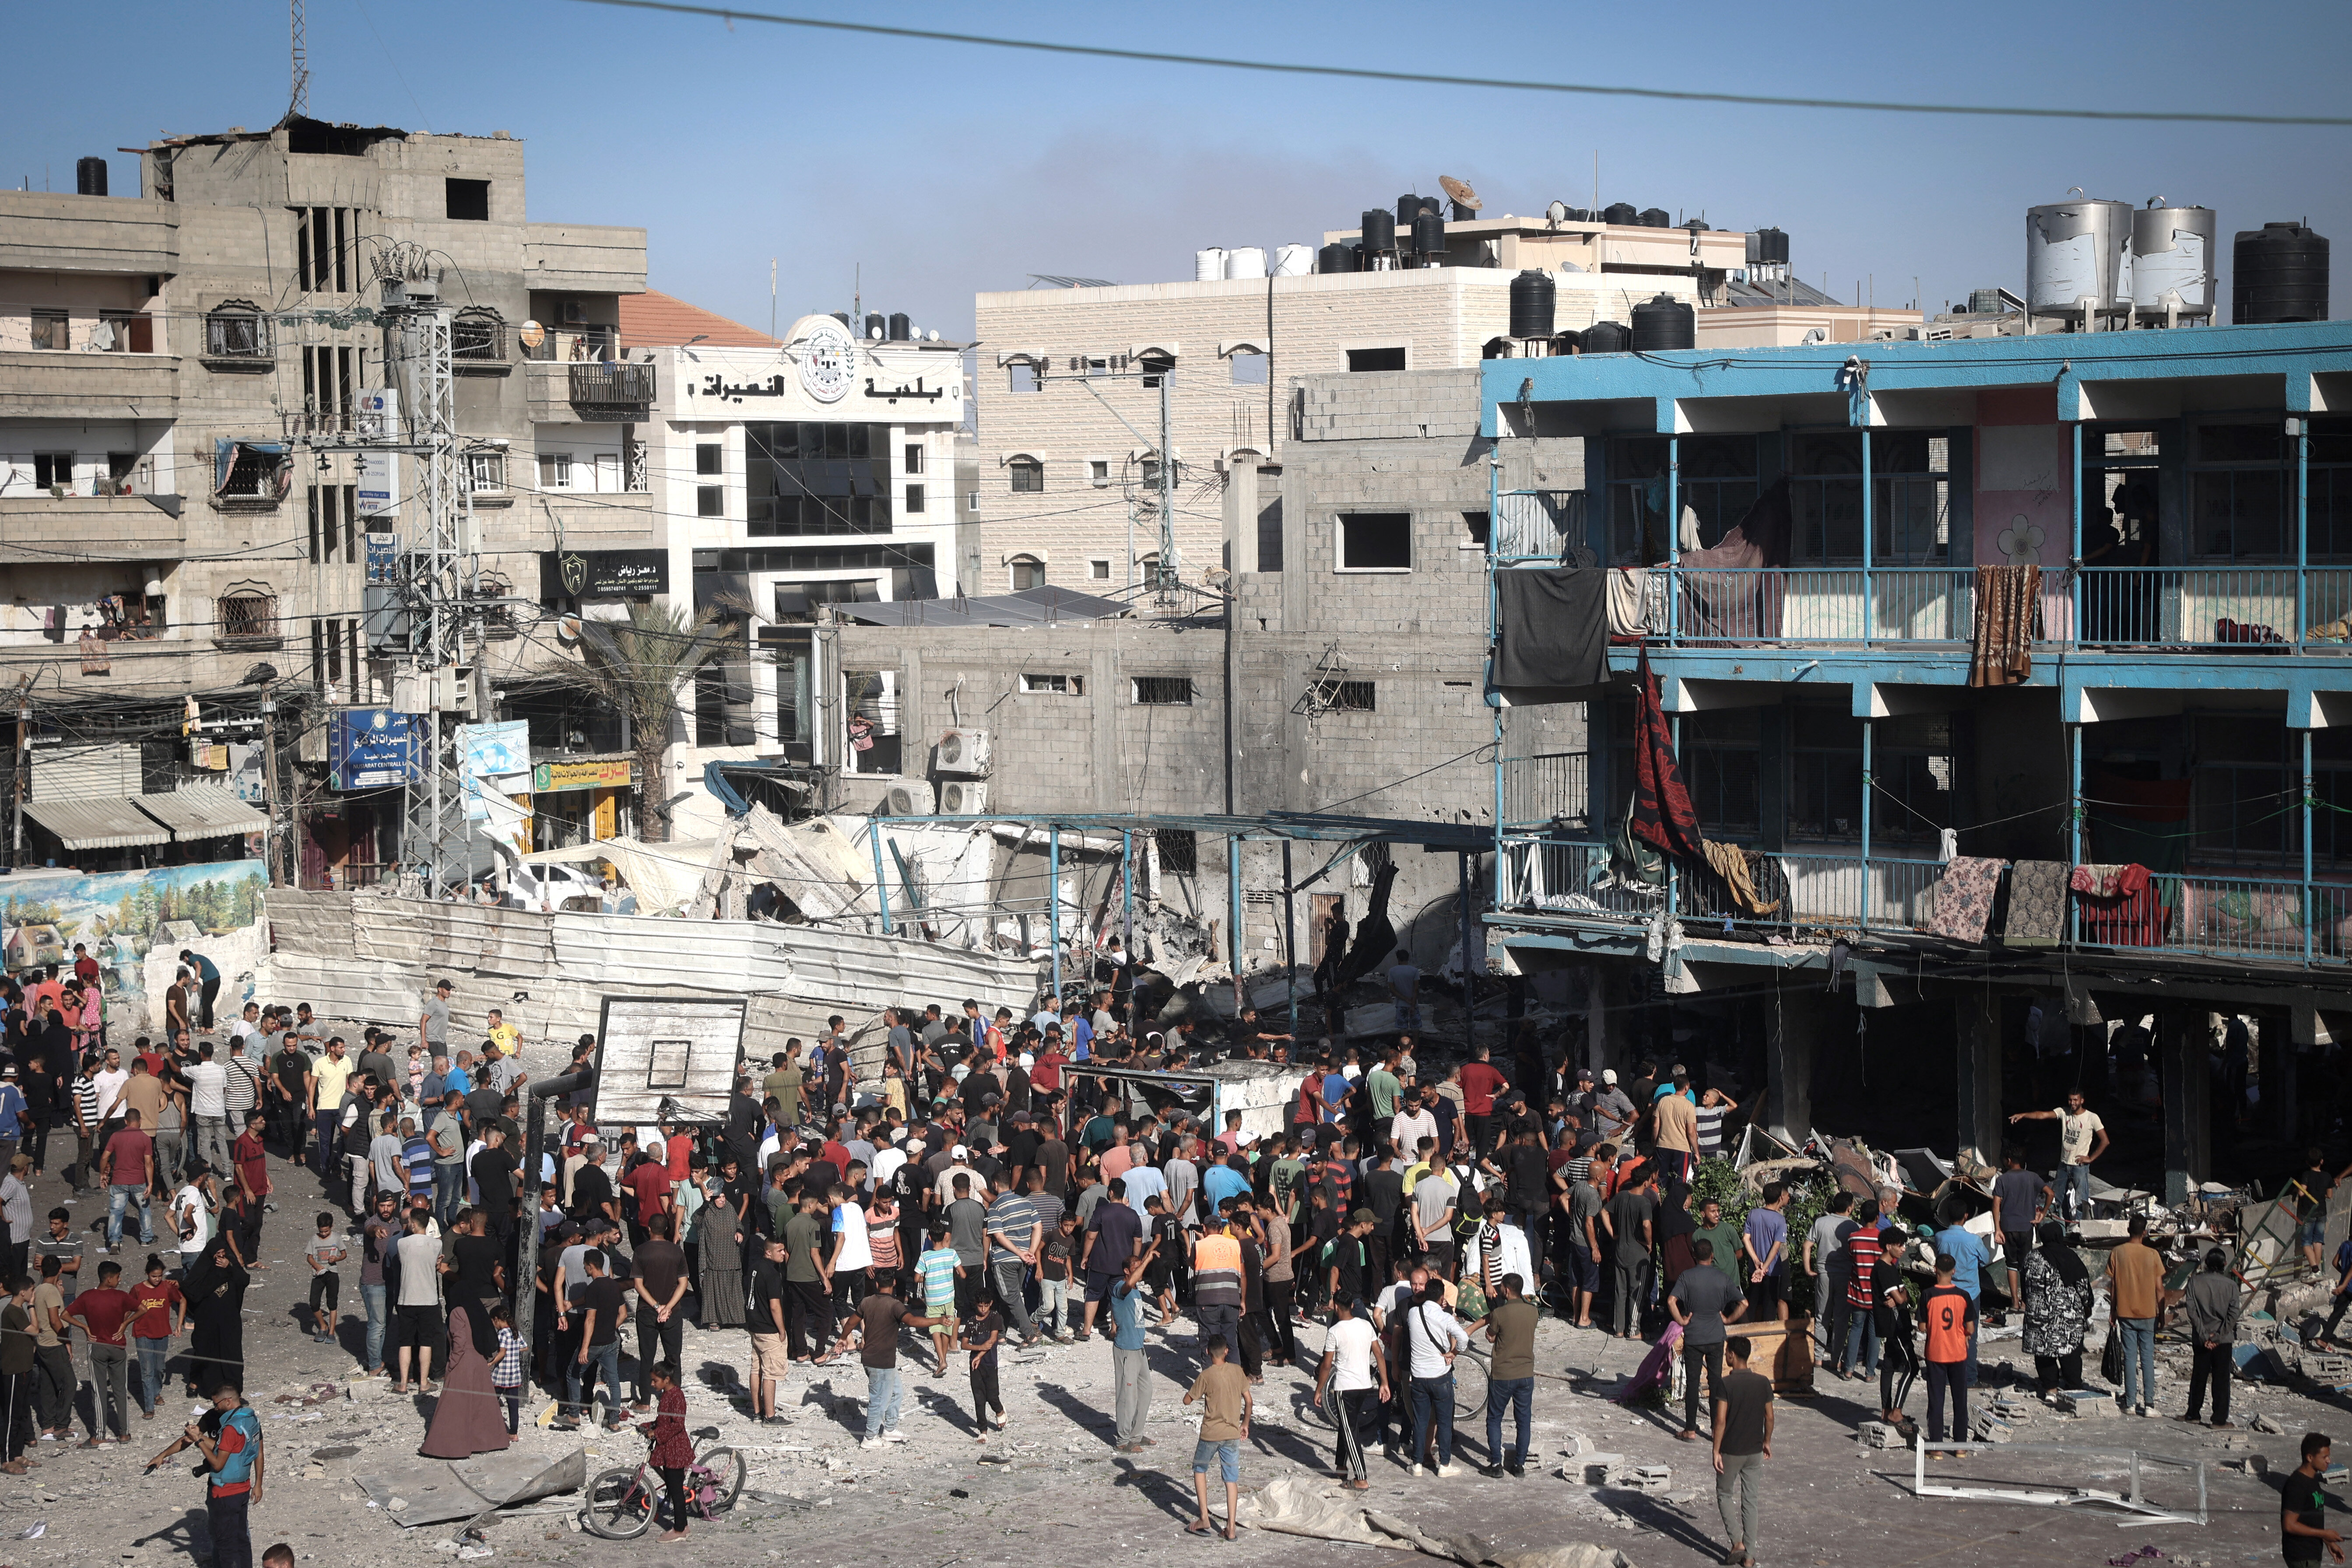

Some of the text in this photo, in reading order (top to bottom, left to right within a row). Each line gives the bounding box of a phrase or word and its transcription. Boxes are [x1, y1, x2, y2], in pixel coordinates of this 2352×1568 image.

[809, 330, 838, 350] دولة فلسطين
[702, 374, 943, 404] بلدية النصيرات
[812, 380, 841, 395] بلدية النصيرات
[359, 499, 378, 510] WINTER
[368, 545, 396, 556] النصيرات
[618, 565, 635, 576] رياض
[393, 716, 408, 727] ختبر
[353, 733, 408, 749] نصيرات المركزي
[581, 769, 598, 778] للصرافة
[599, 763, 628, 780] الترك
[2065, 1129, 2081, 1139] DEVIL'S
[2063, 1136, 2078, 1146] PHONE
[140, 1298, 166, 1310] Workout
[1942, 1307, 1954, 1331] 9
